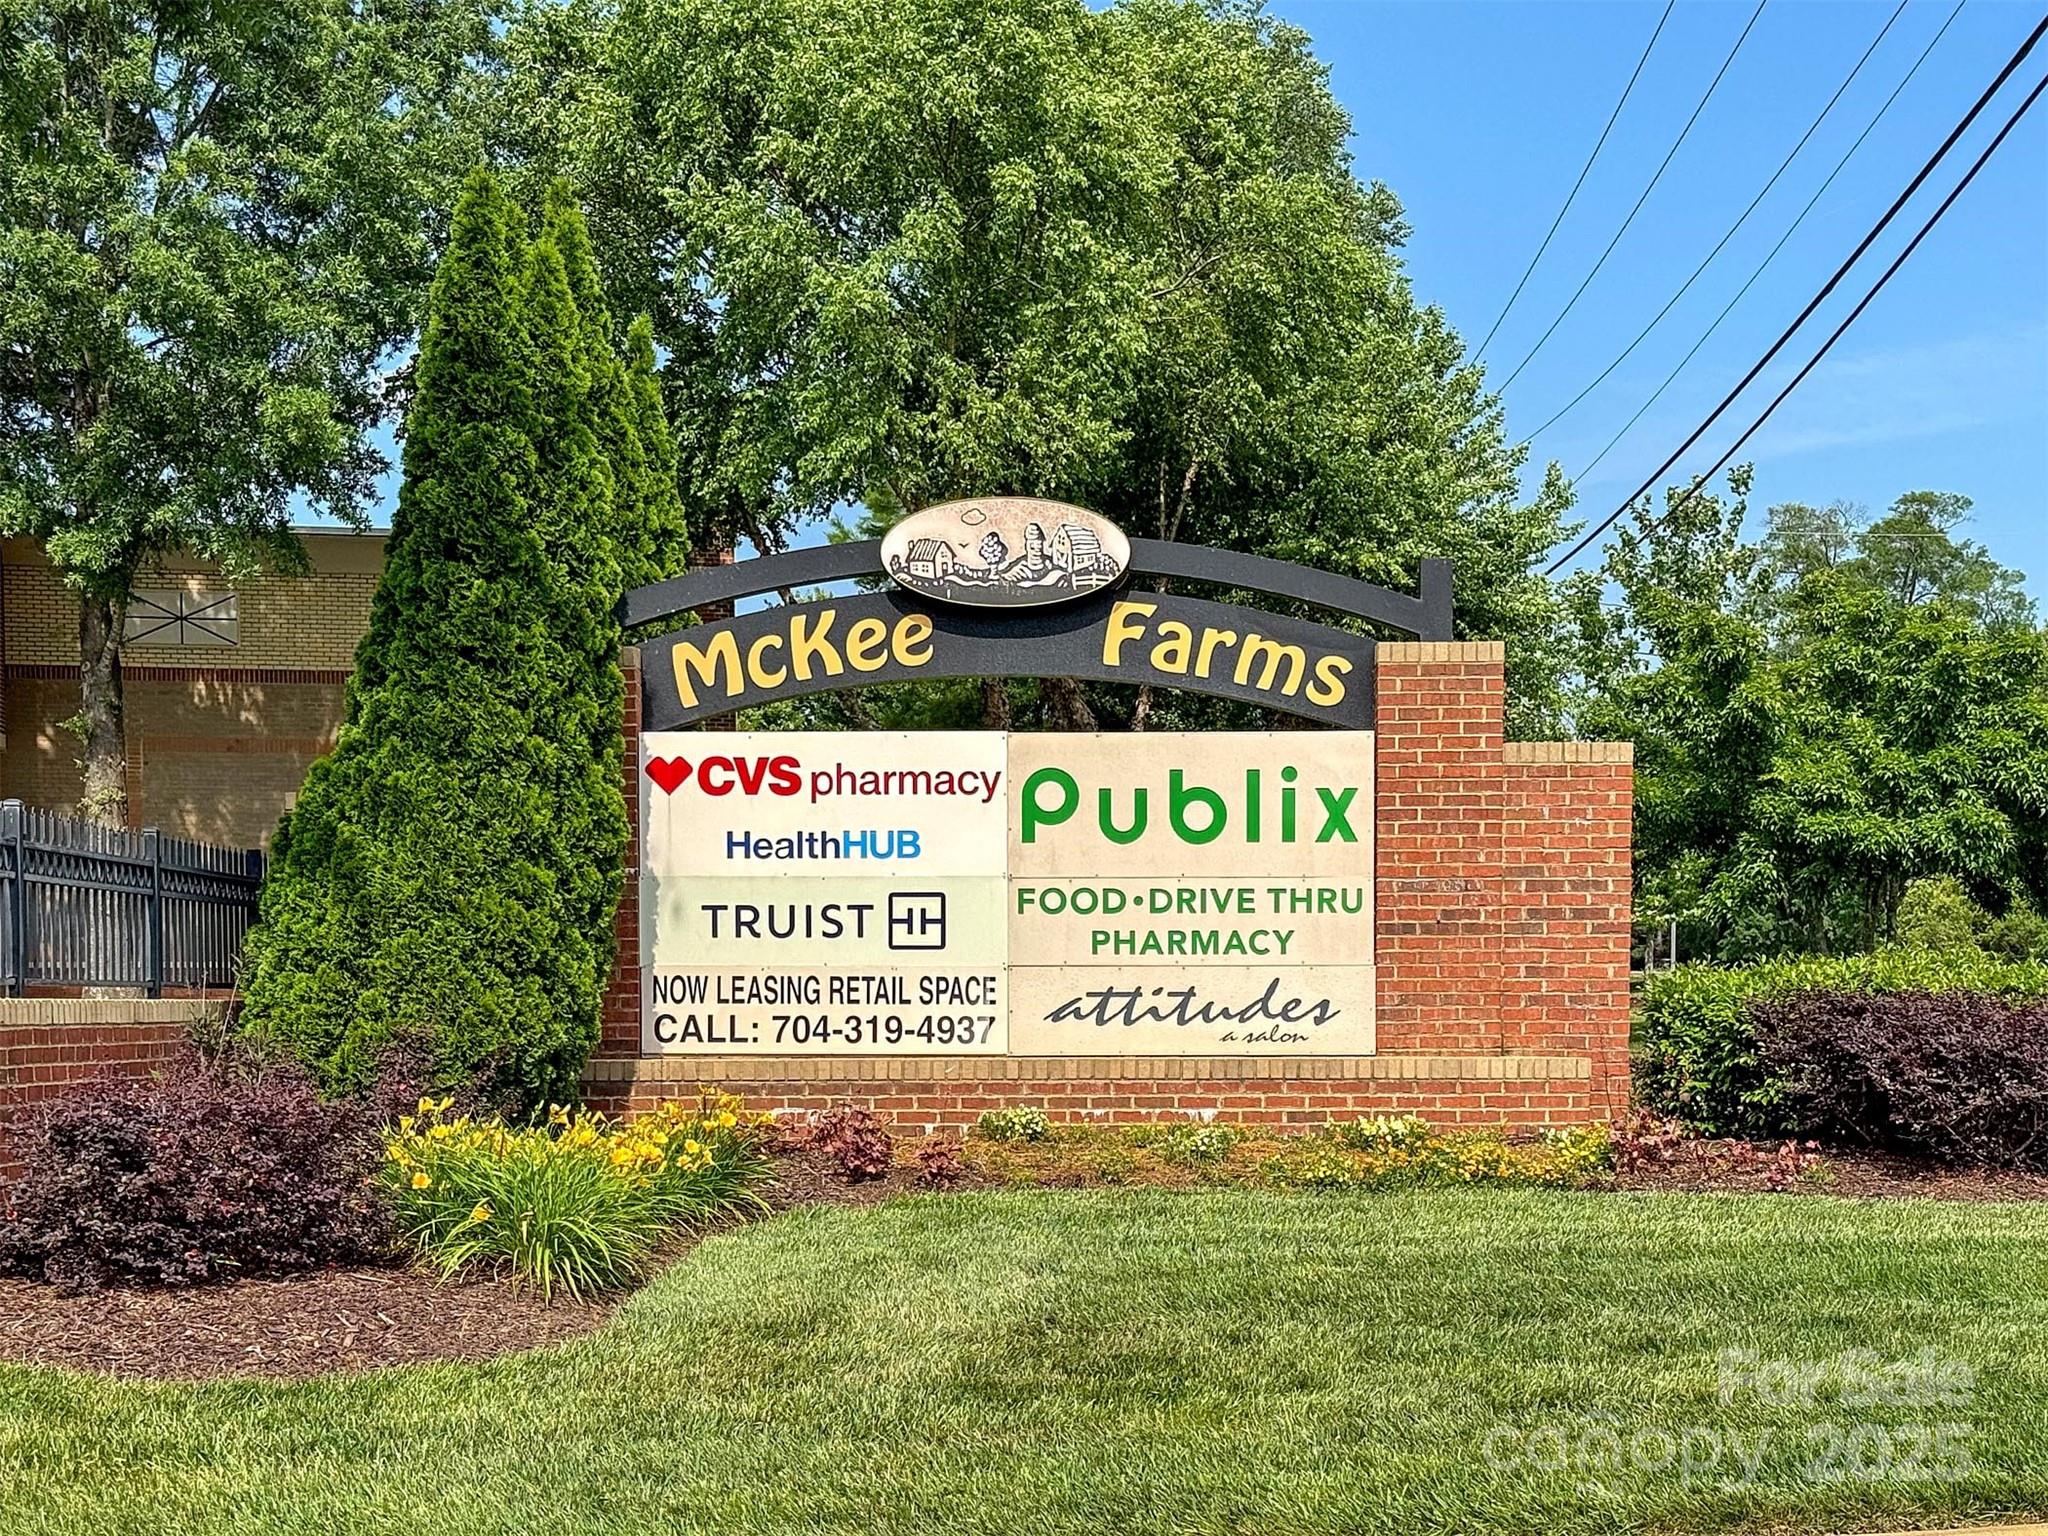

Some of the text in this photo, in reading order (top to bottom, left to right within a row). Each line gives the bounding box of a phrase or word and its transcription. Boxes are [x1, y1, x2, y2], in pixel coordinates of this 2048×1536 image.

[672, 601, 1354, 708] McKee Farms
[697, 756, 1002, 806] CVS pharmacy
[1021, 766, 1360, 845] Publix
[727, 831, 922, 861] HealthHUB
[1267, 888, 1364, 915] THRU
[701, 904, 876, 940] TRUIST
[1091, 930, 1296, 957] PHARMACY
[652, 975, 998, 1006] NOW LEASING RETAIL SPACE
[1044, 978, 1342, 1027] attitudes
[653, 1014, 997, 1046] CALL: 704-319-4937
[1219, 1024, 1311, 1044] a salon
